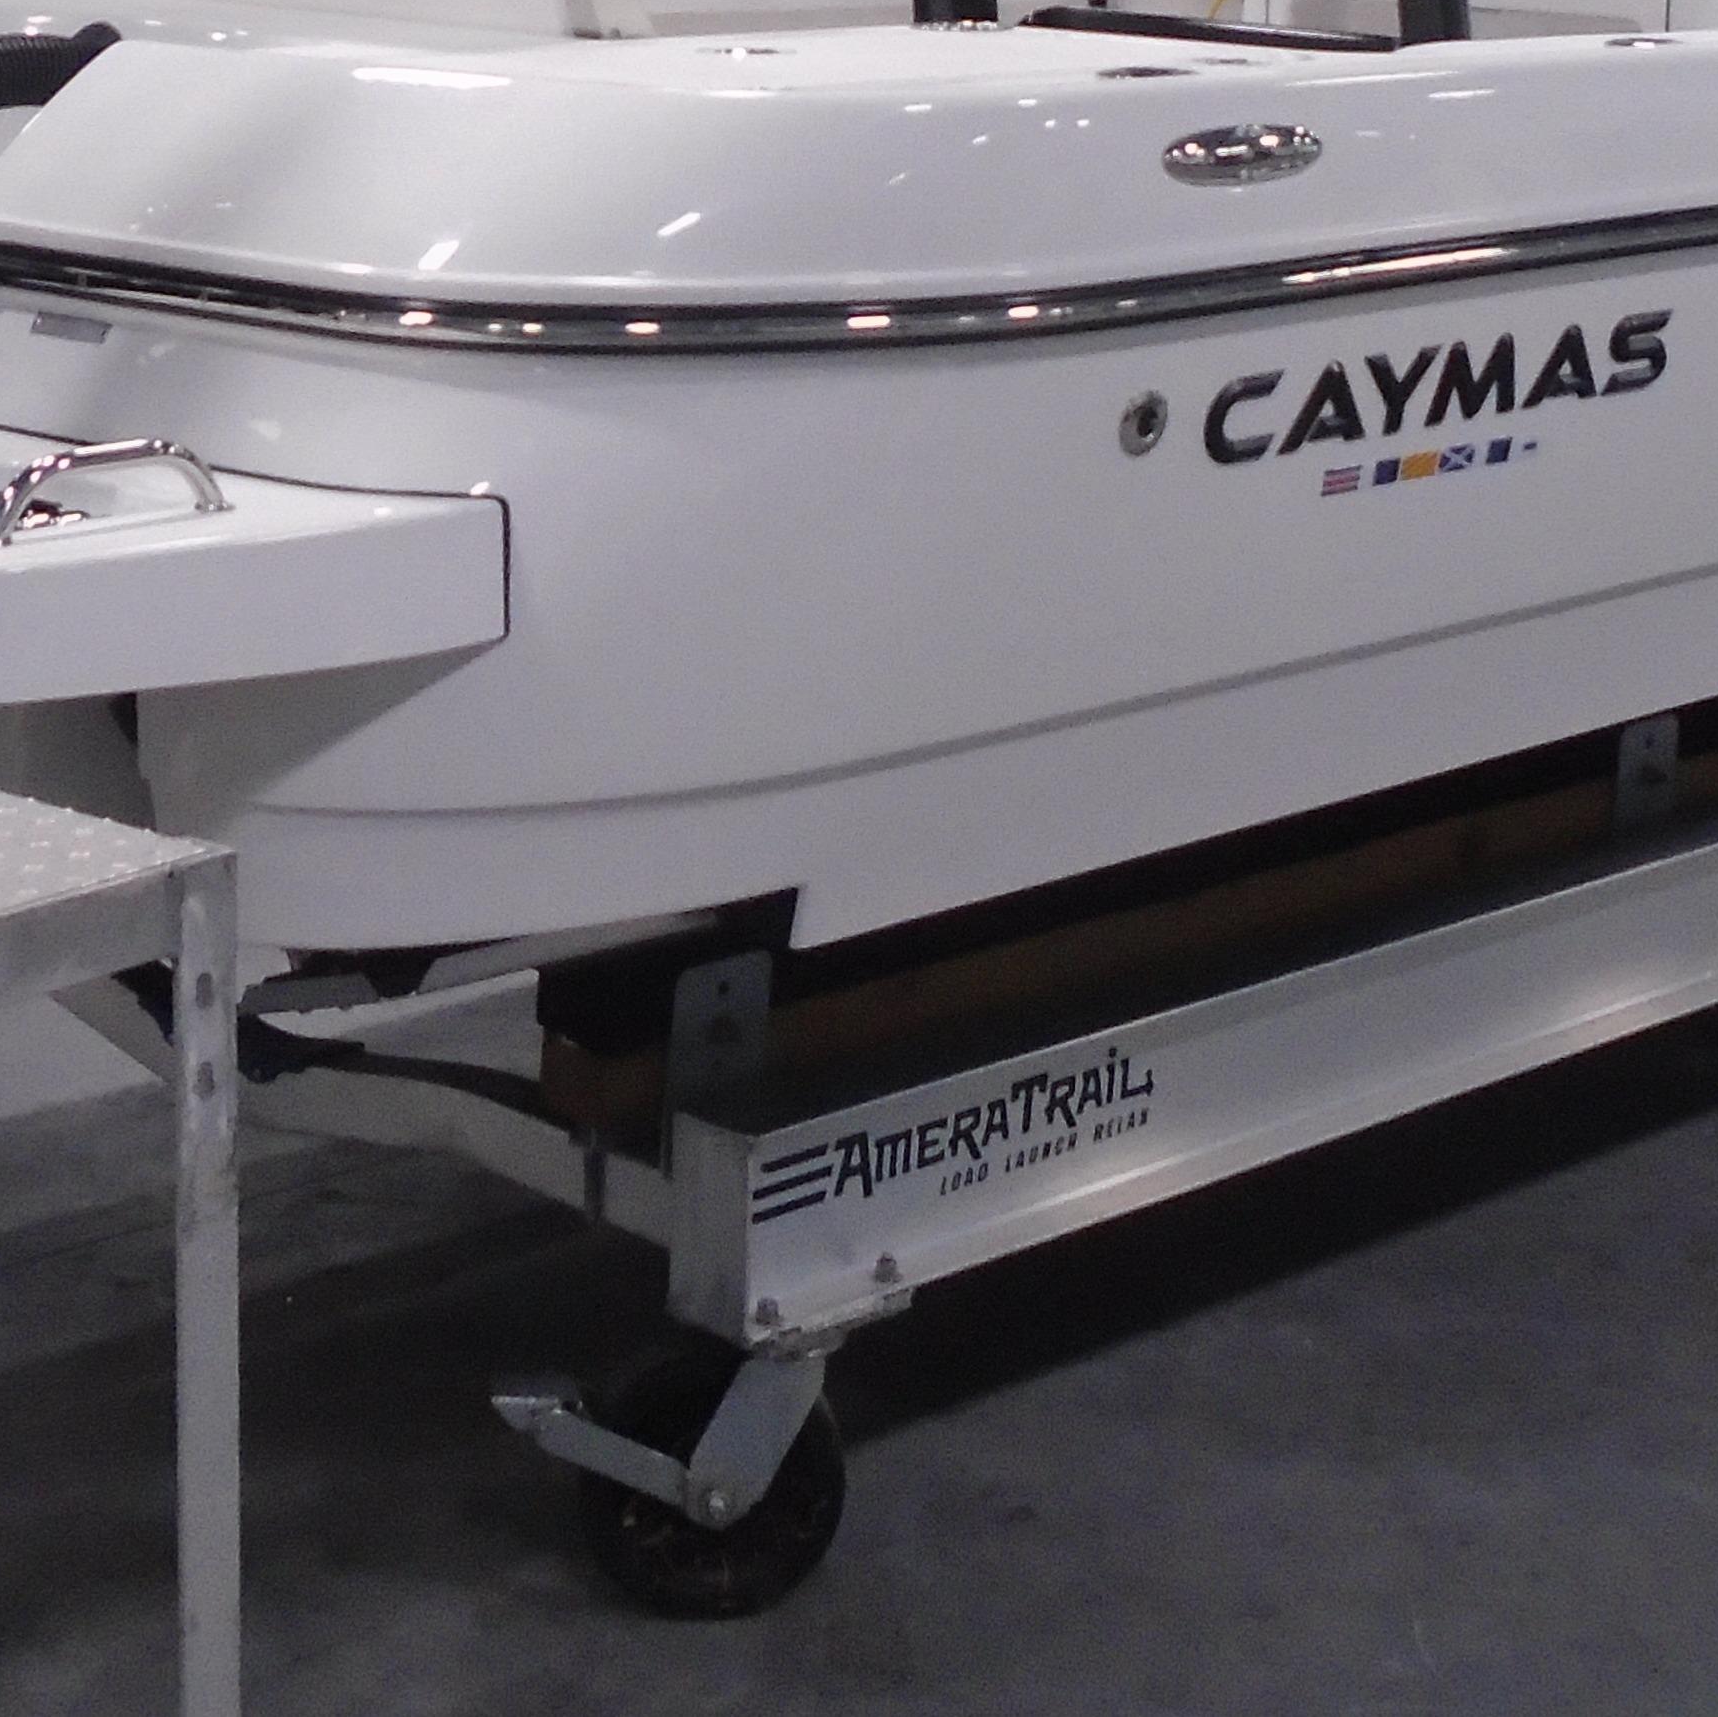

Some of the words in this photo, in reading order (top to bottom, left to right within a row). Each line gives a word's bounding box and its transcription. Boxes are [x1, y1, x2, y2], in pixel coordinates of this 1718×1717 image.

[1203, 308, 1673, 465] CAYMAS
[940, 1162, 989, 1196] LOAD
[1005, 1132, 1078, 1172] LAUNCH
[1093, 1107, 1149, 1143] RELAX
